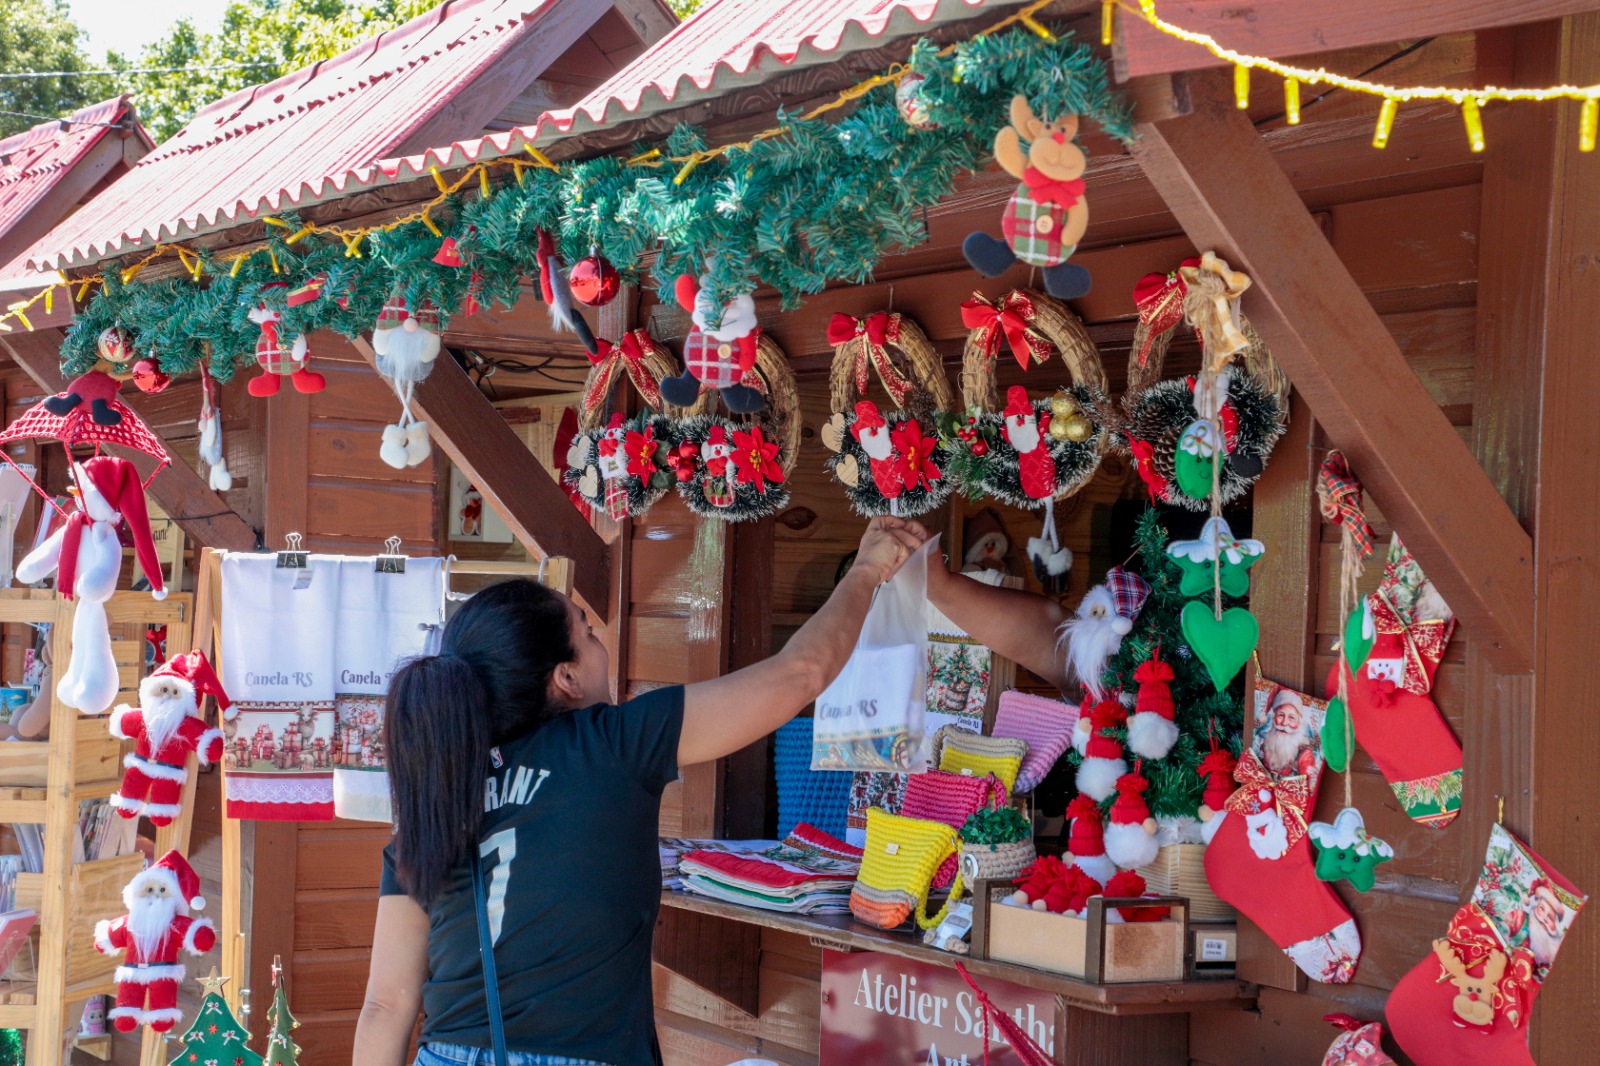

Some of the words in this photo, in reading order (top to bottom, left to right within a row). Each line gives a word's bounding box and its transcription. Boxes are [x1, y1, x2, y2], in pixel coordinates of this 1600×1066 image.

[245, 672, 288, 687] Canela
[292, 672, 313, 687] RS
[341, 669, 381, 685] Canela
[820, 702, 853, 720] Cana
[856, 699, 878, 718] RS
[479, 827, 516, 949] 7
[853, 967, 948, 1028] Atelier
[954, 991, 1055, 1058] Sath
